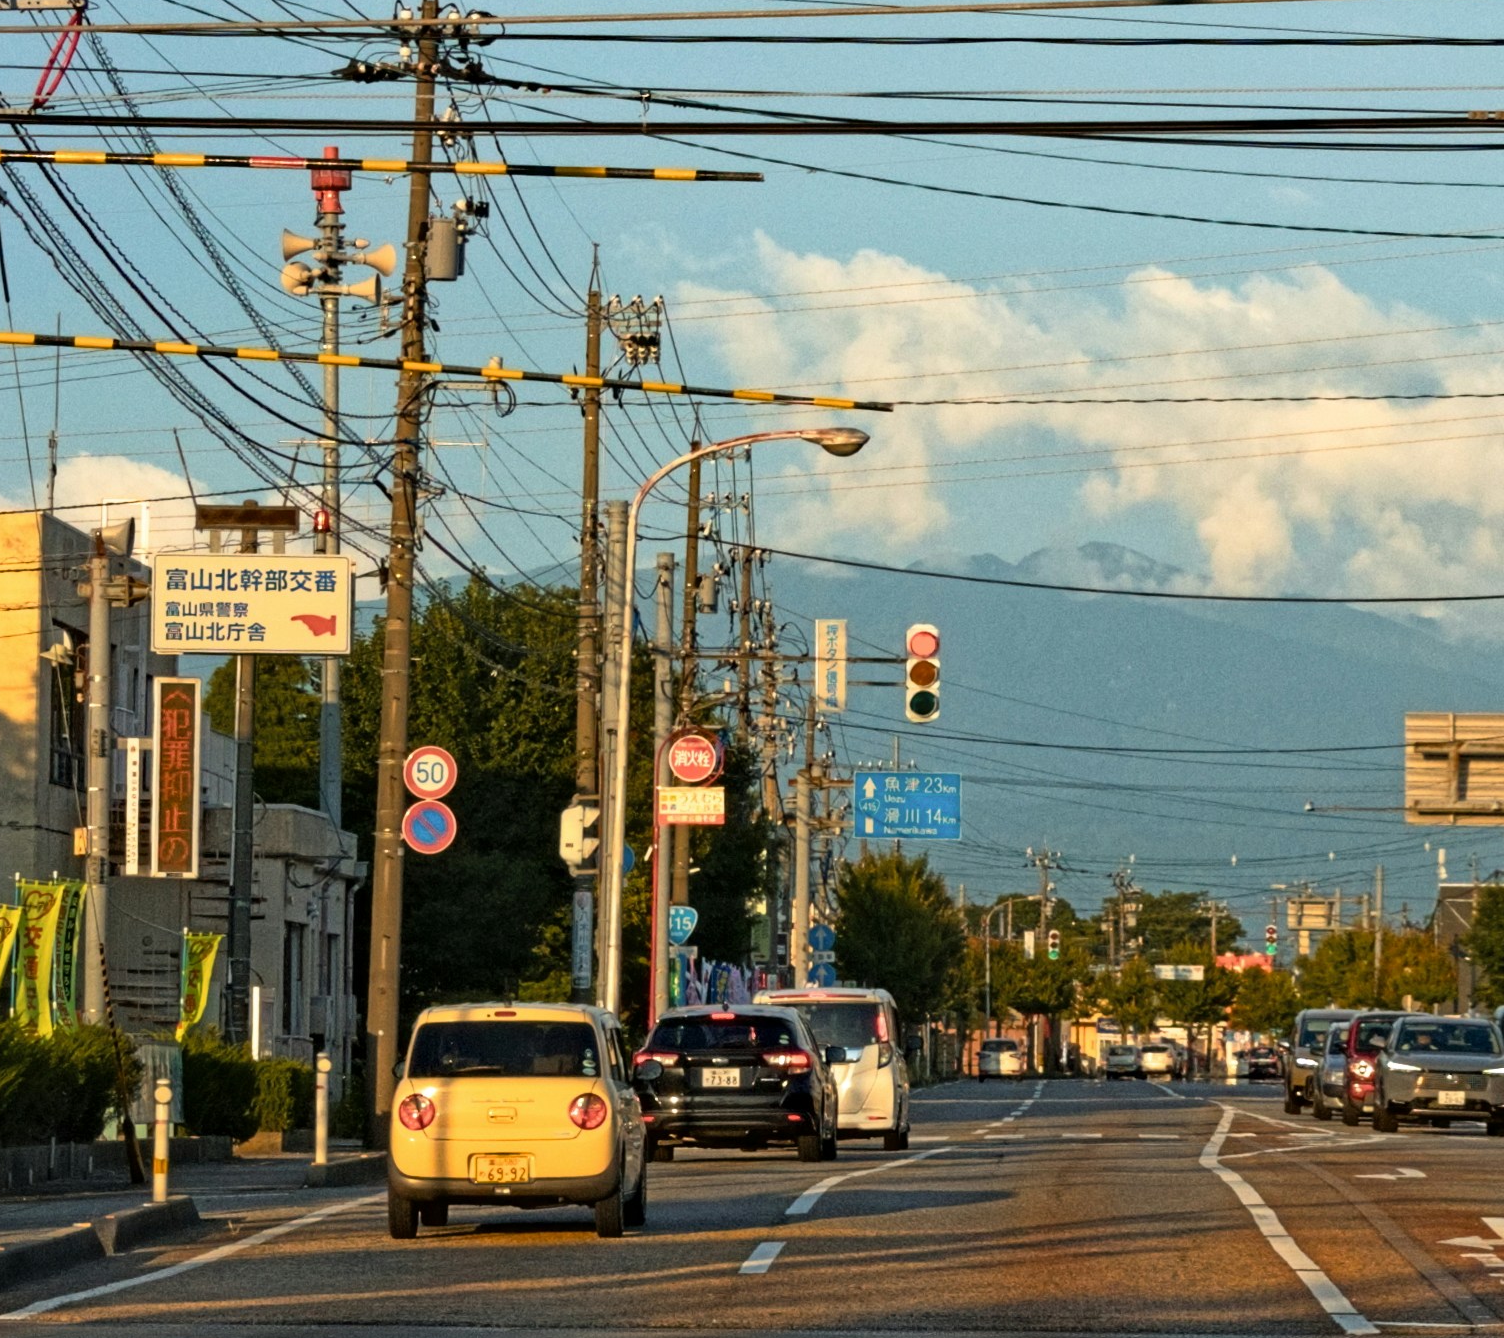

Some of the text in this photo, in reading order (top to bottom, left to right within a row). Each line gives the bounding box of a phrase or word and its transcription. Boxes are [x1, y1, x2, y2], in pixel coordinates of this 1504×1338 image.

[165, 568, 337, 593] 富山北幹部交番
[165, 601, 249, 618] 富山県警察
[165, 622, 267, 642] 富山北庁舎
[674, 749, 711, 767] 消火栓
[416, 761, 445, 784] 50
[884, 777, 920, 792] 魚津
[487, 1167, 526, 1182] 69-92
